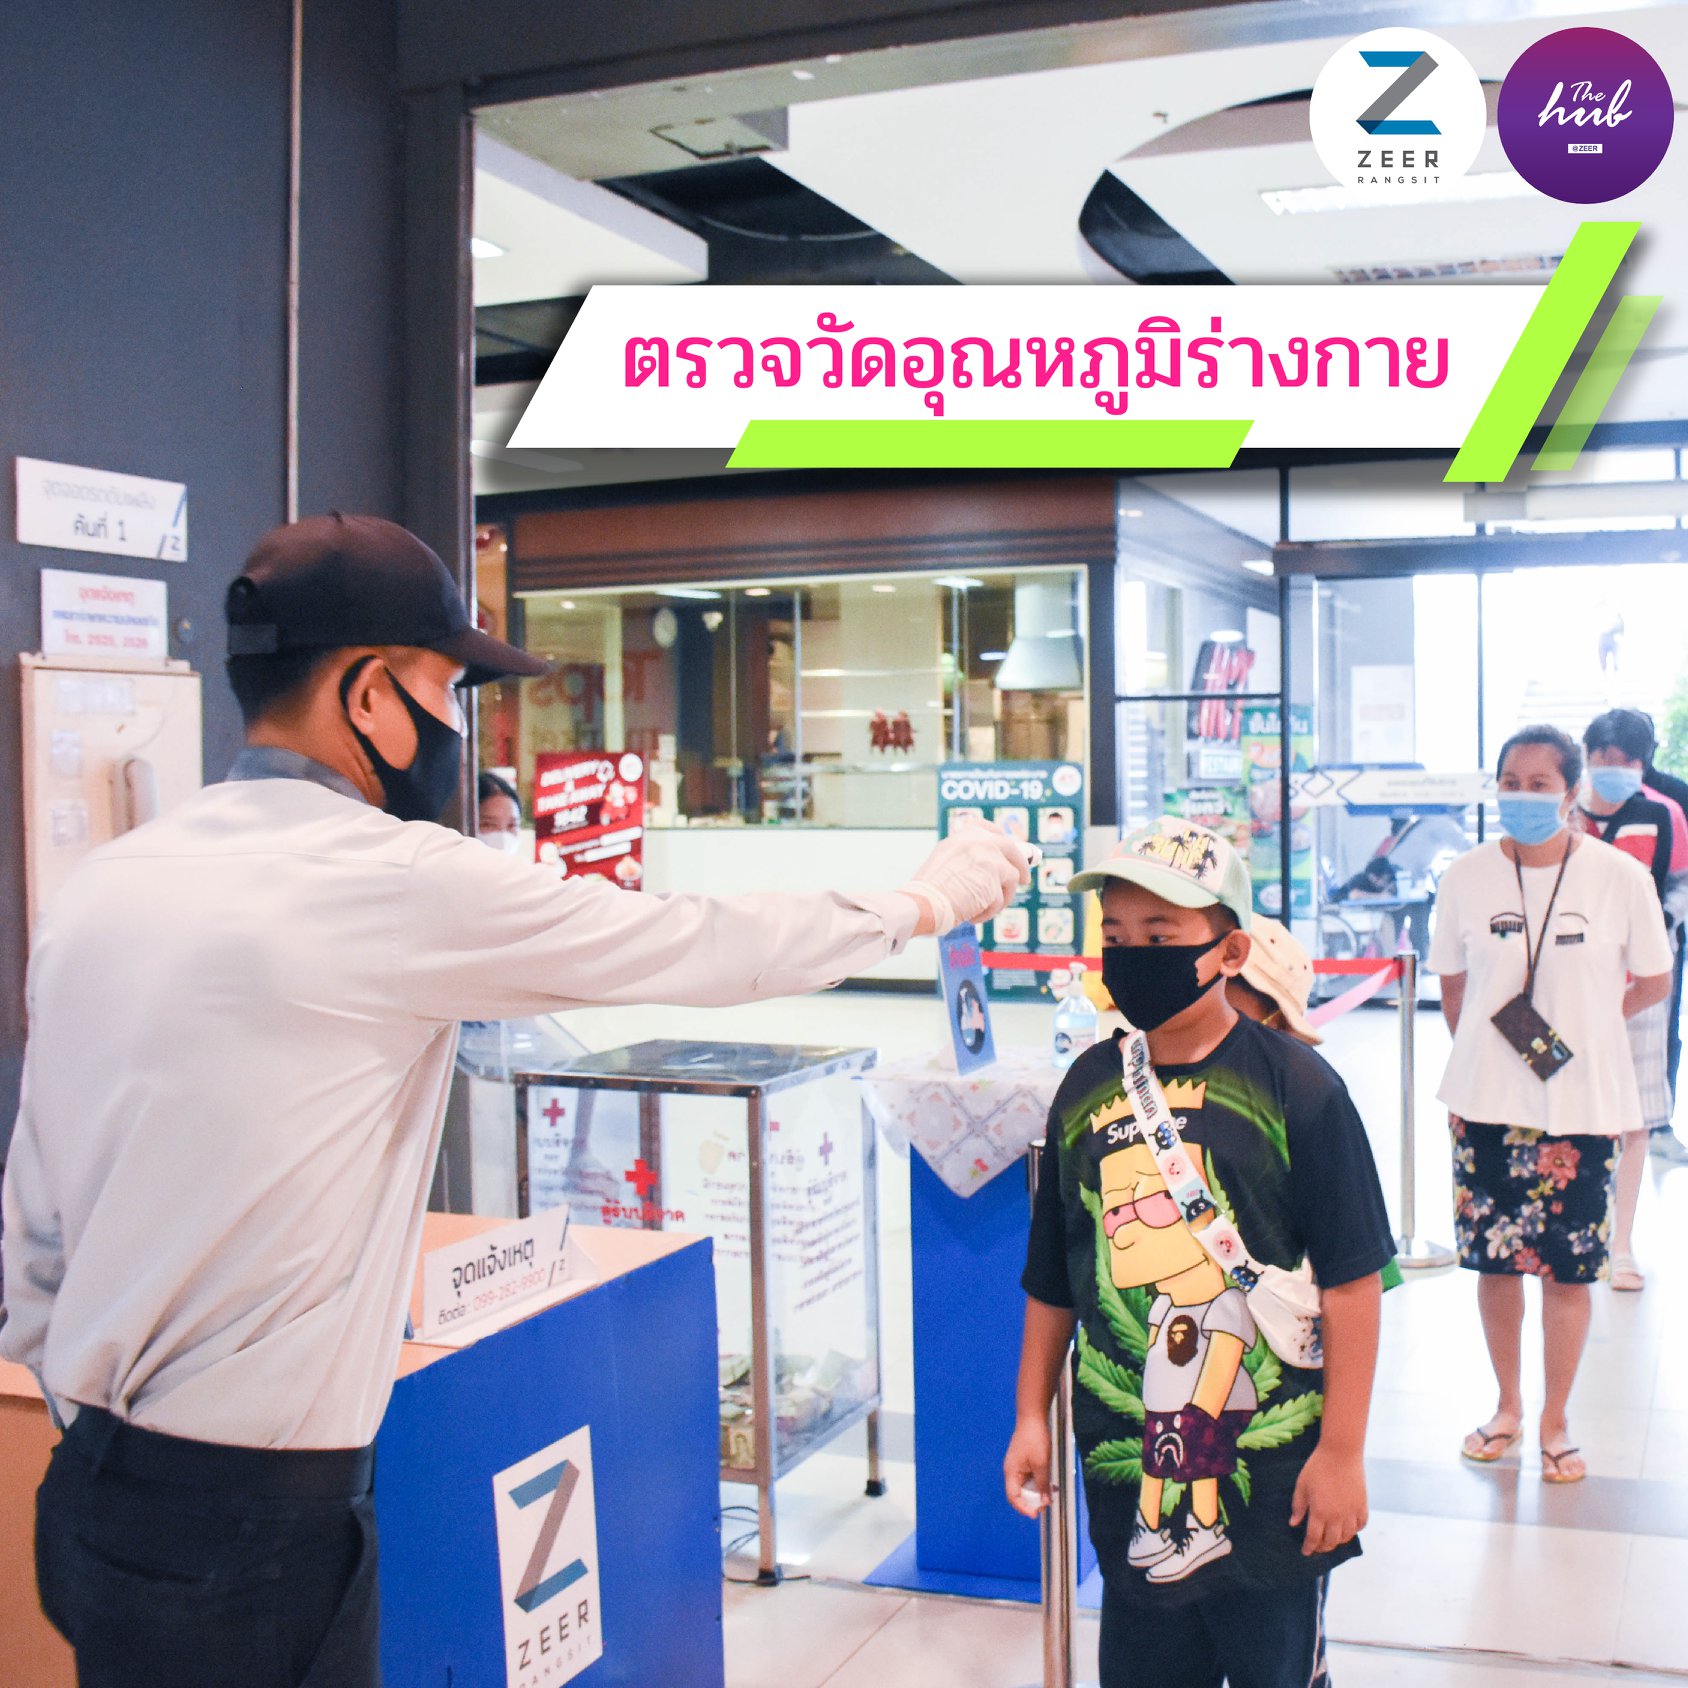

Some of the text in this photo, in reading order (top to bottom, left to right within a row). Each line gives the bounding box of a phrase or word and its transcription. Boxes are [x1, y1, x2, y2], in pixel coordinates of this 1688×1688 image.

[73, 511, 127, 542] คันที่ 1
[941, 780, 1044, 800] COVID-19
[1107, 1116, 1187, 1144] Supe
[452, 1238, 534, 1299] จุดแจ้งเหตุ
[518, 1599, 589, 1670] ZEER
